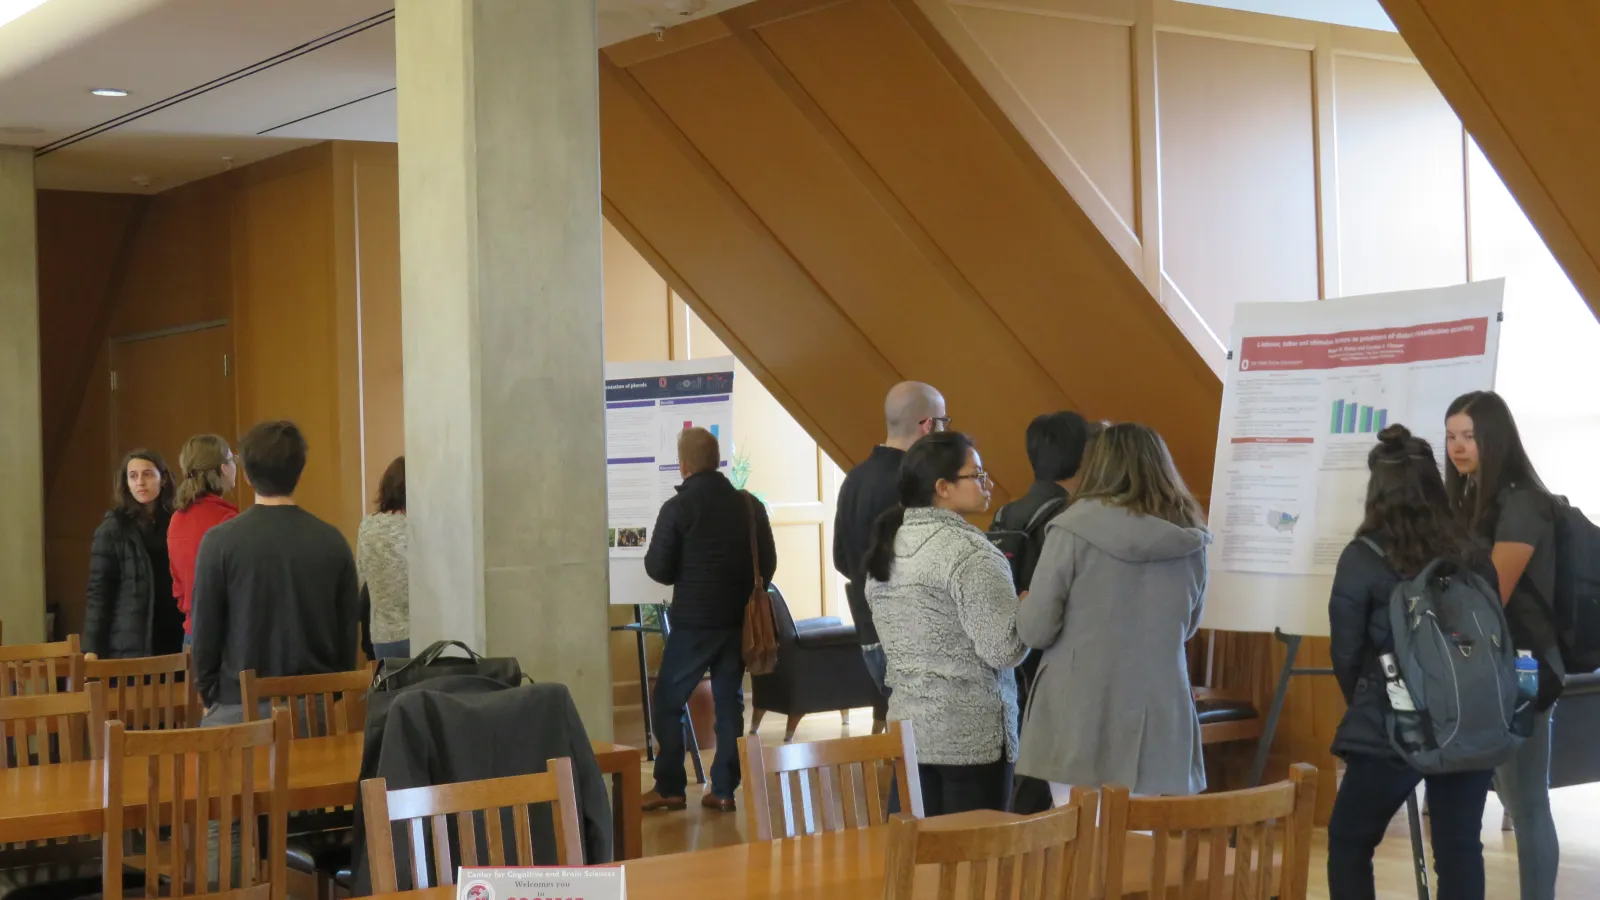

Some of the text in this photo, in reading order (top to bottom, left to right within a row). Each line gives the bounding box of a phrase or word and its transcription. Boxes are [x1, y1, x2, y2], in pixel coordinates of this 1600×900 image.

[494, 870, 506, 878] for
[507, 870, 543, 880] Cognitive
[544, 870, 560, 878] and
[556, 881, 571, 889] you
